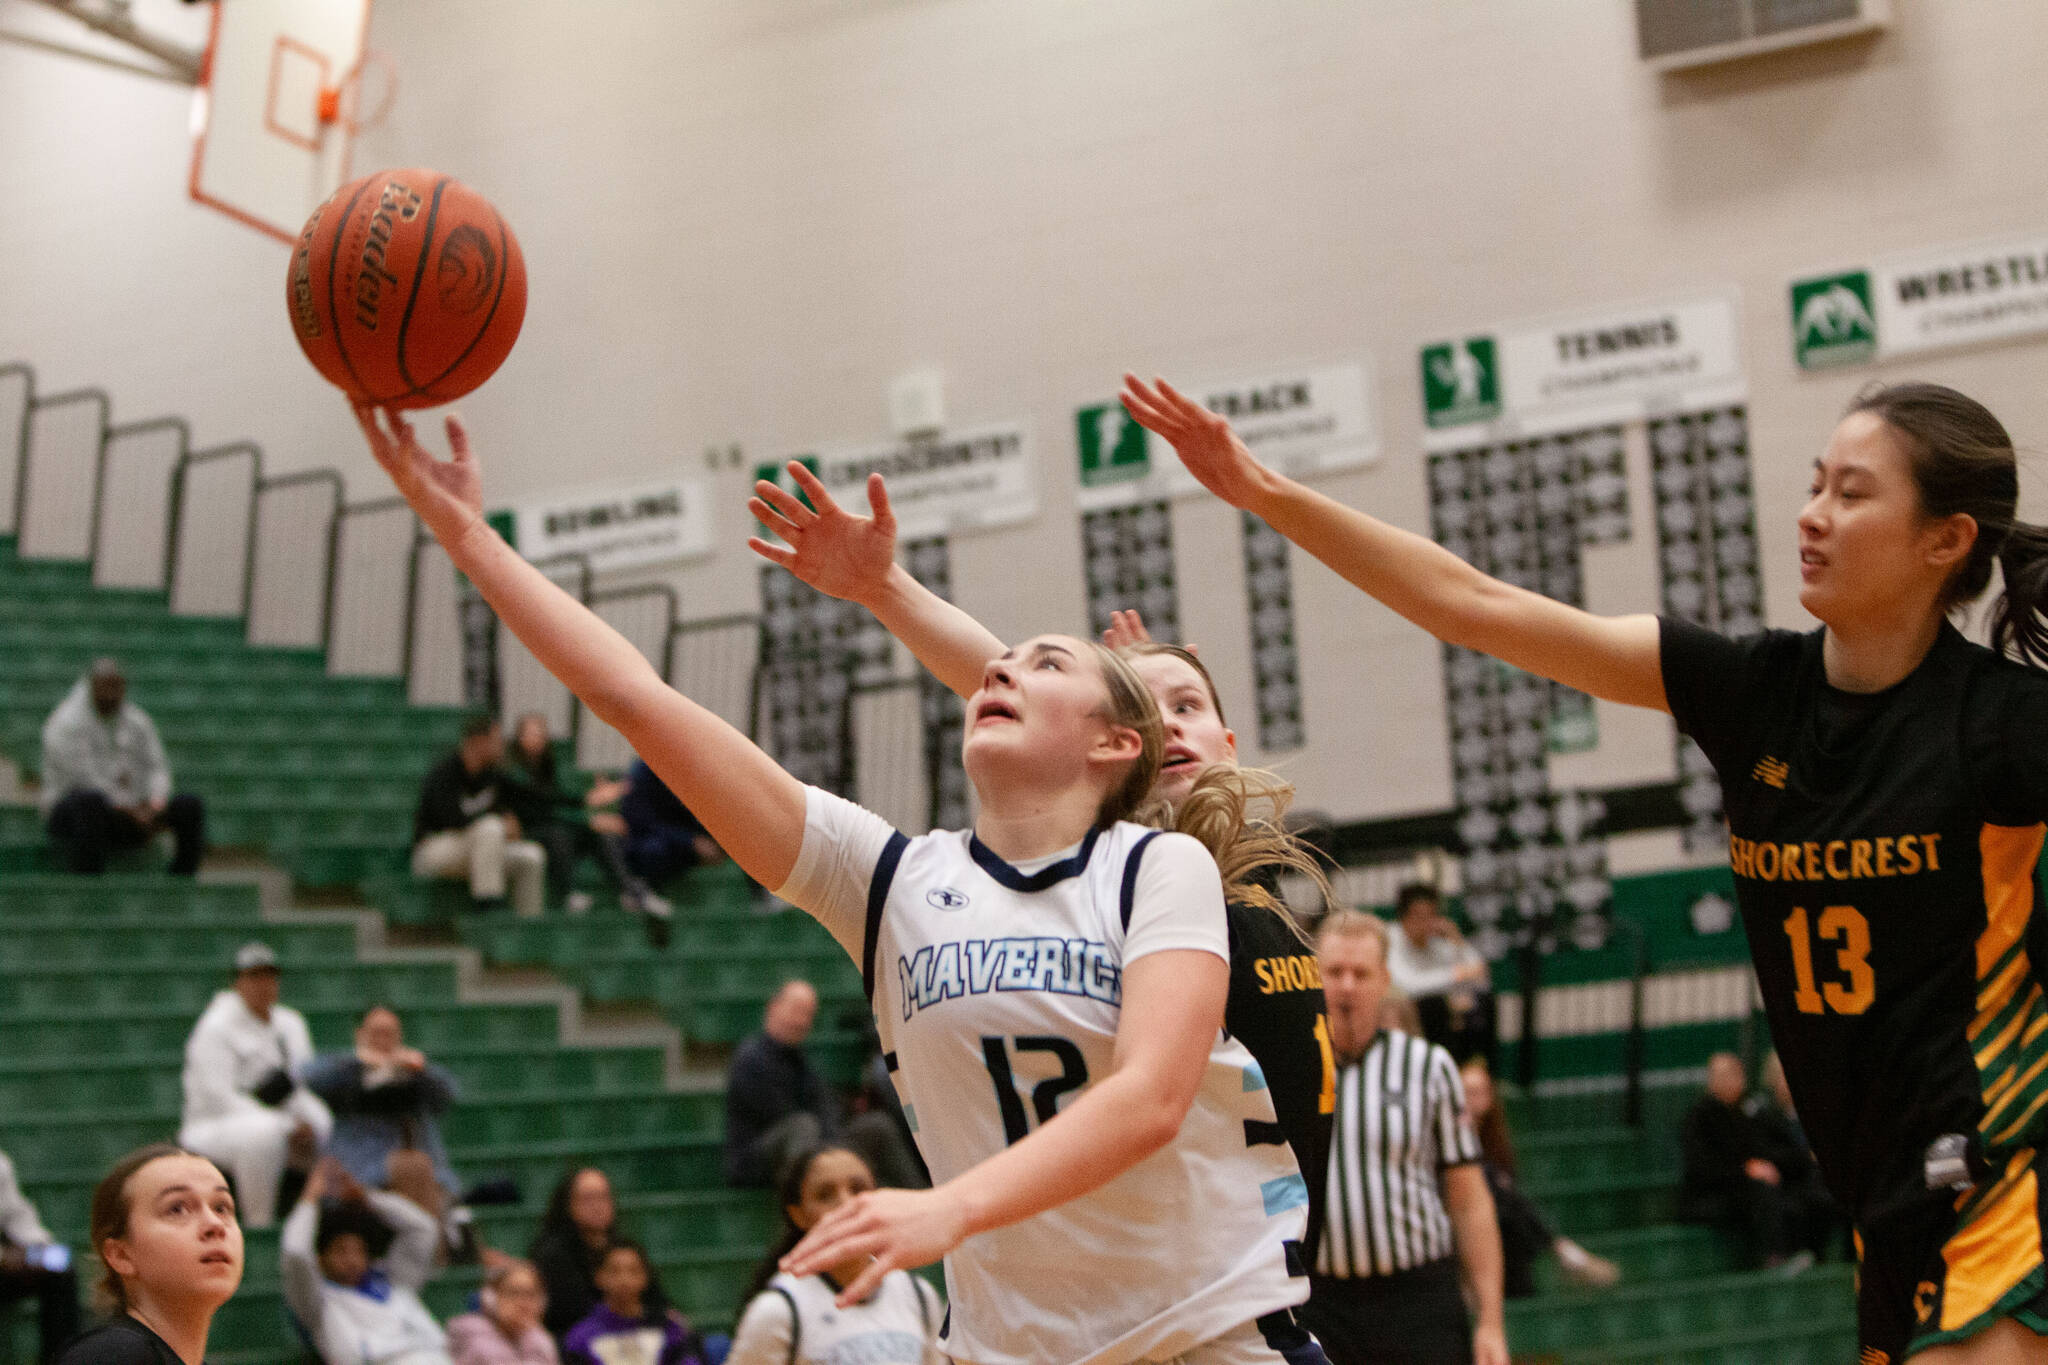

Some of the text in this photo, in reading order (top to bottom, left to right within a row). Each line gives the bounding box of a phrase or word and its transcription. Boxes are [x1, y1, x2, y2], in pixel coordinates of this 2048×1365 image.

[354, 180, 423, 332] Baden
[1555, 315, 1679, 363] TENNIS
[543, 489, 683, 537] BOWLING
[1730, 832, 1942, 882] SHORECREST
[1783, 904, 1876, 1016] 13
[980, 1035, 1089, 1148] 12
